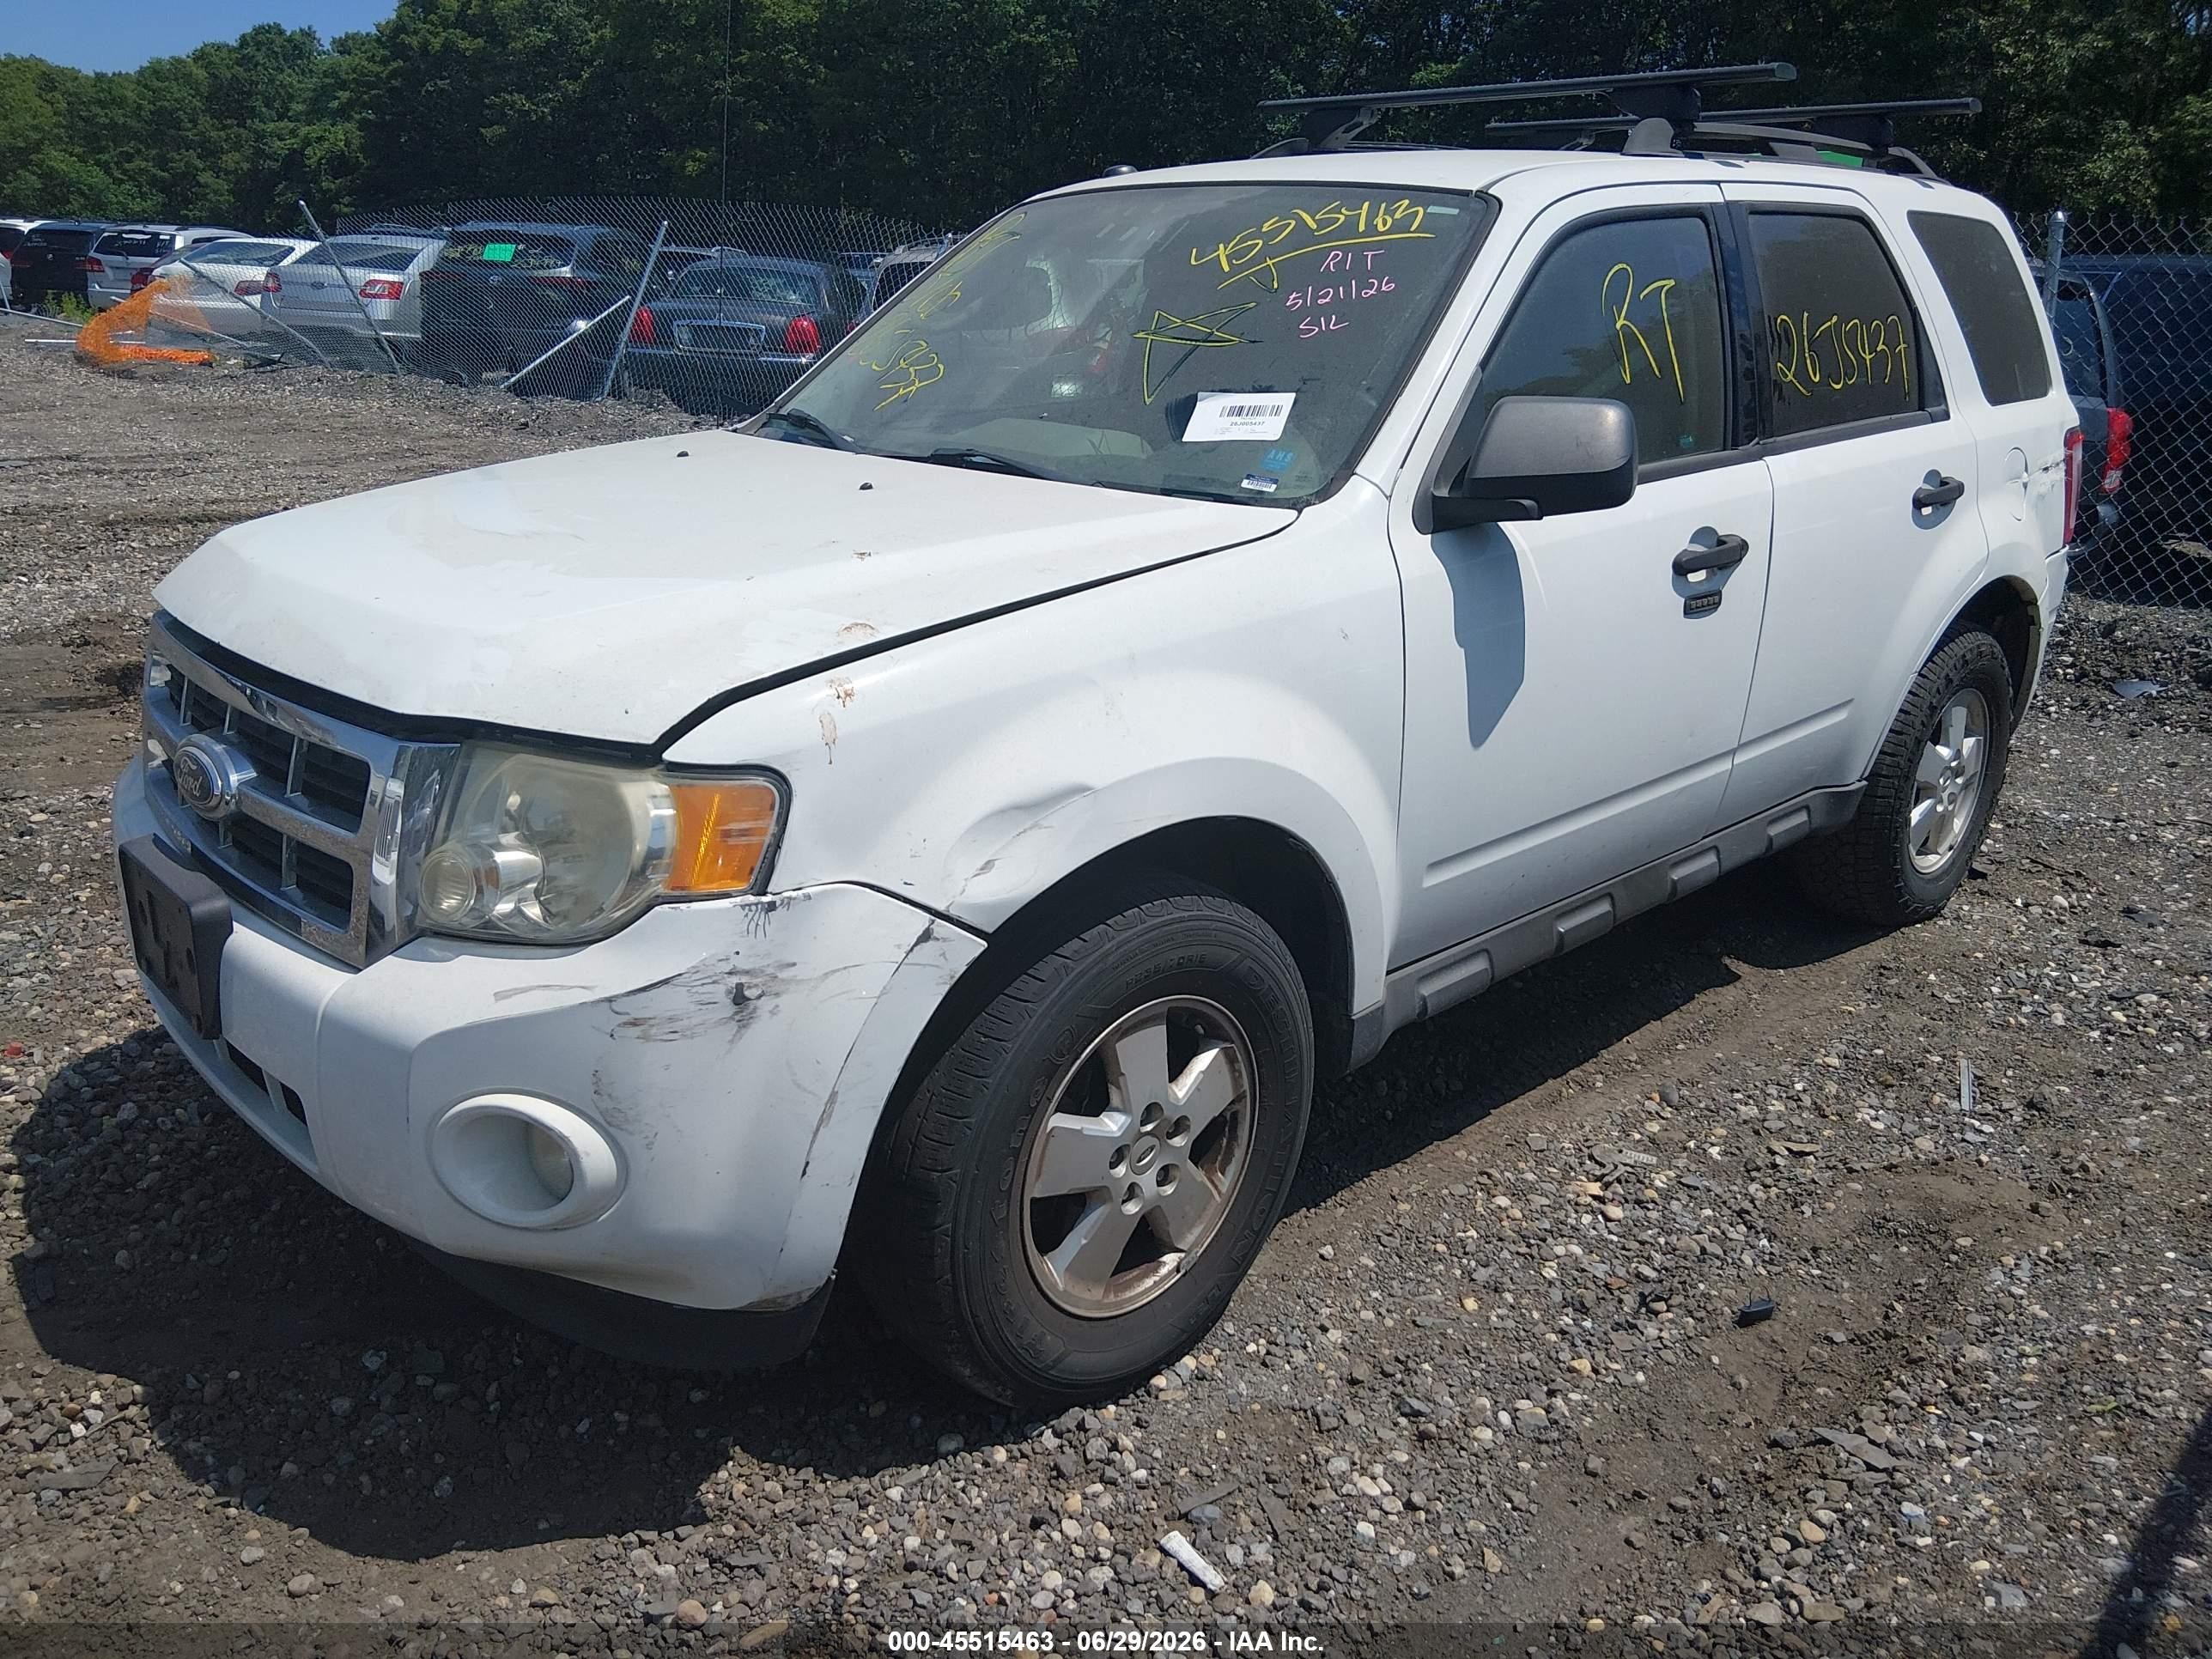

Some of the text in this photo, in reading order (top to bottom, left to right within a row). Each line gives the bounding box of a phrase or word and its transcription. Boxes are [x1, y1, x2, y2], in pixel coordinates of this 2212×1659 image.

[1190, 199, 1425, 272] 45515463
[1601, 263, 1685, 405] RT
[178, 757, 203, 797] Ford
